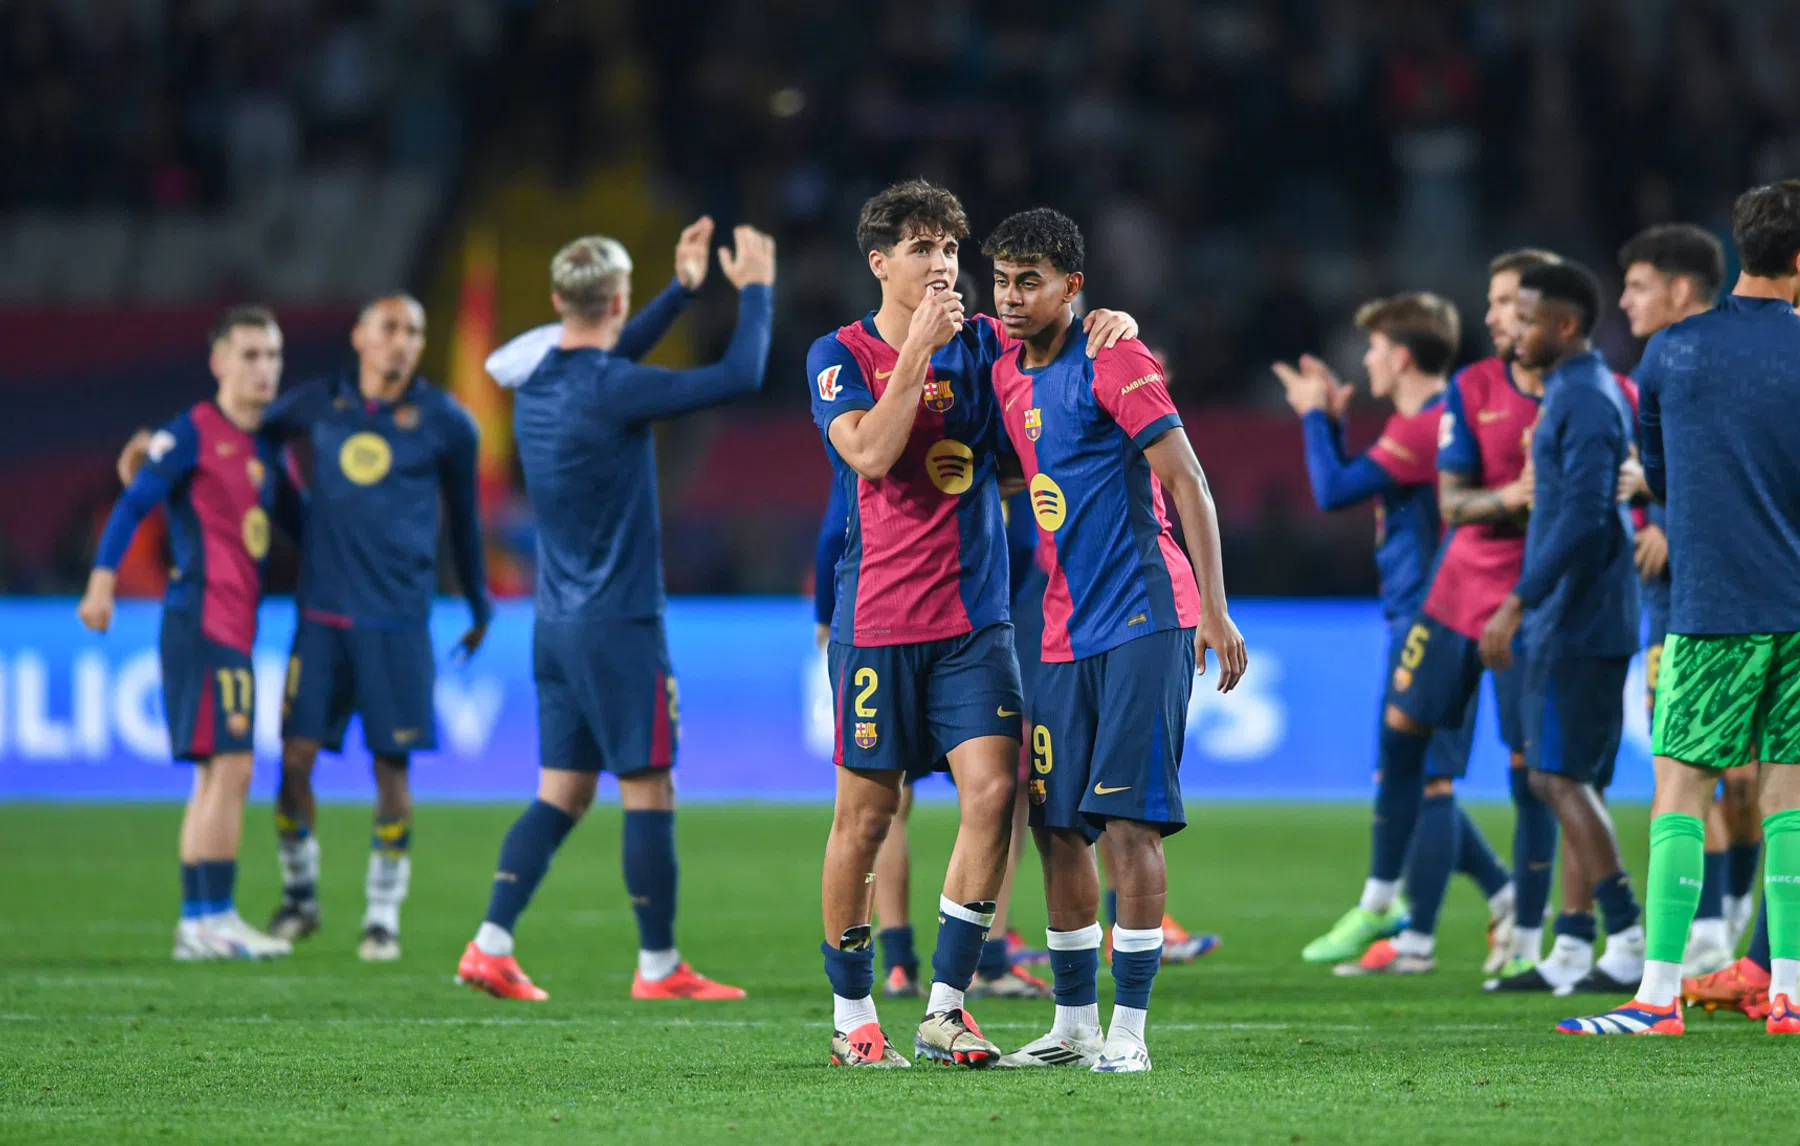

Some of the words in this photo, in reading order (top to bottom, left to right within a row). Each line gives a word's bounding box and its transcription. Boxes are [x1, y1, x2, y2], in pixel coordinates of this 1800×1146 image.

[1402, 624, 1430, 669] 5
[218, 668, 252, 713] 11
[854, 667, 878, 717] 2
[1033, 724, 1053, 774] 9
